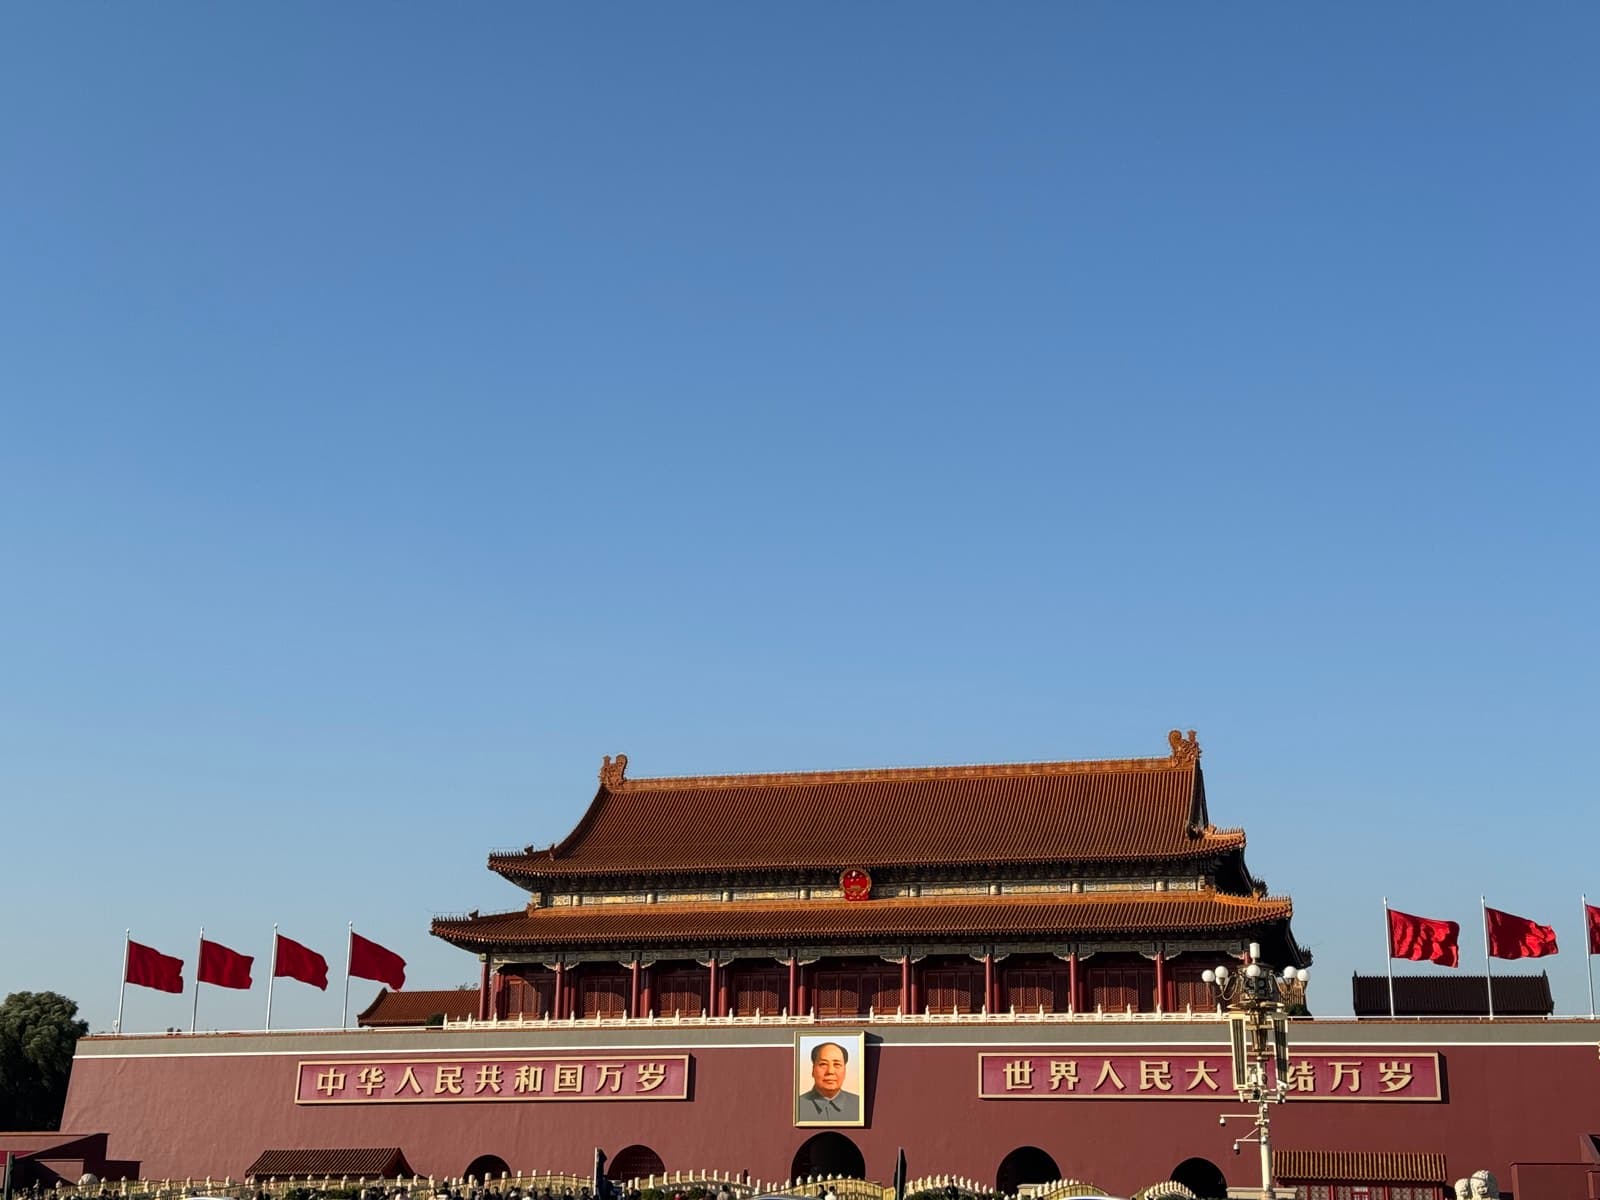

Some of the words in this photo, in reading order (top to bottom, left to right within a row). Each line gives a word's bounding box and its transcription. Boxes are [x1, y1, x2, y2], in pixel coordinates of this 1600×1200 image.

[316, 1063, 667, 1096] 中华人民共和国万岁
[1003, 1060, 1415, 1092] 世界人民大结万岁
